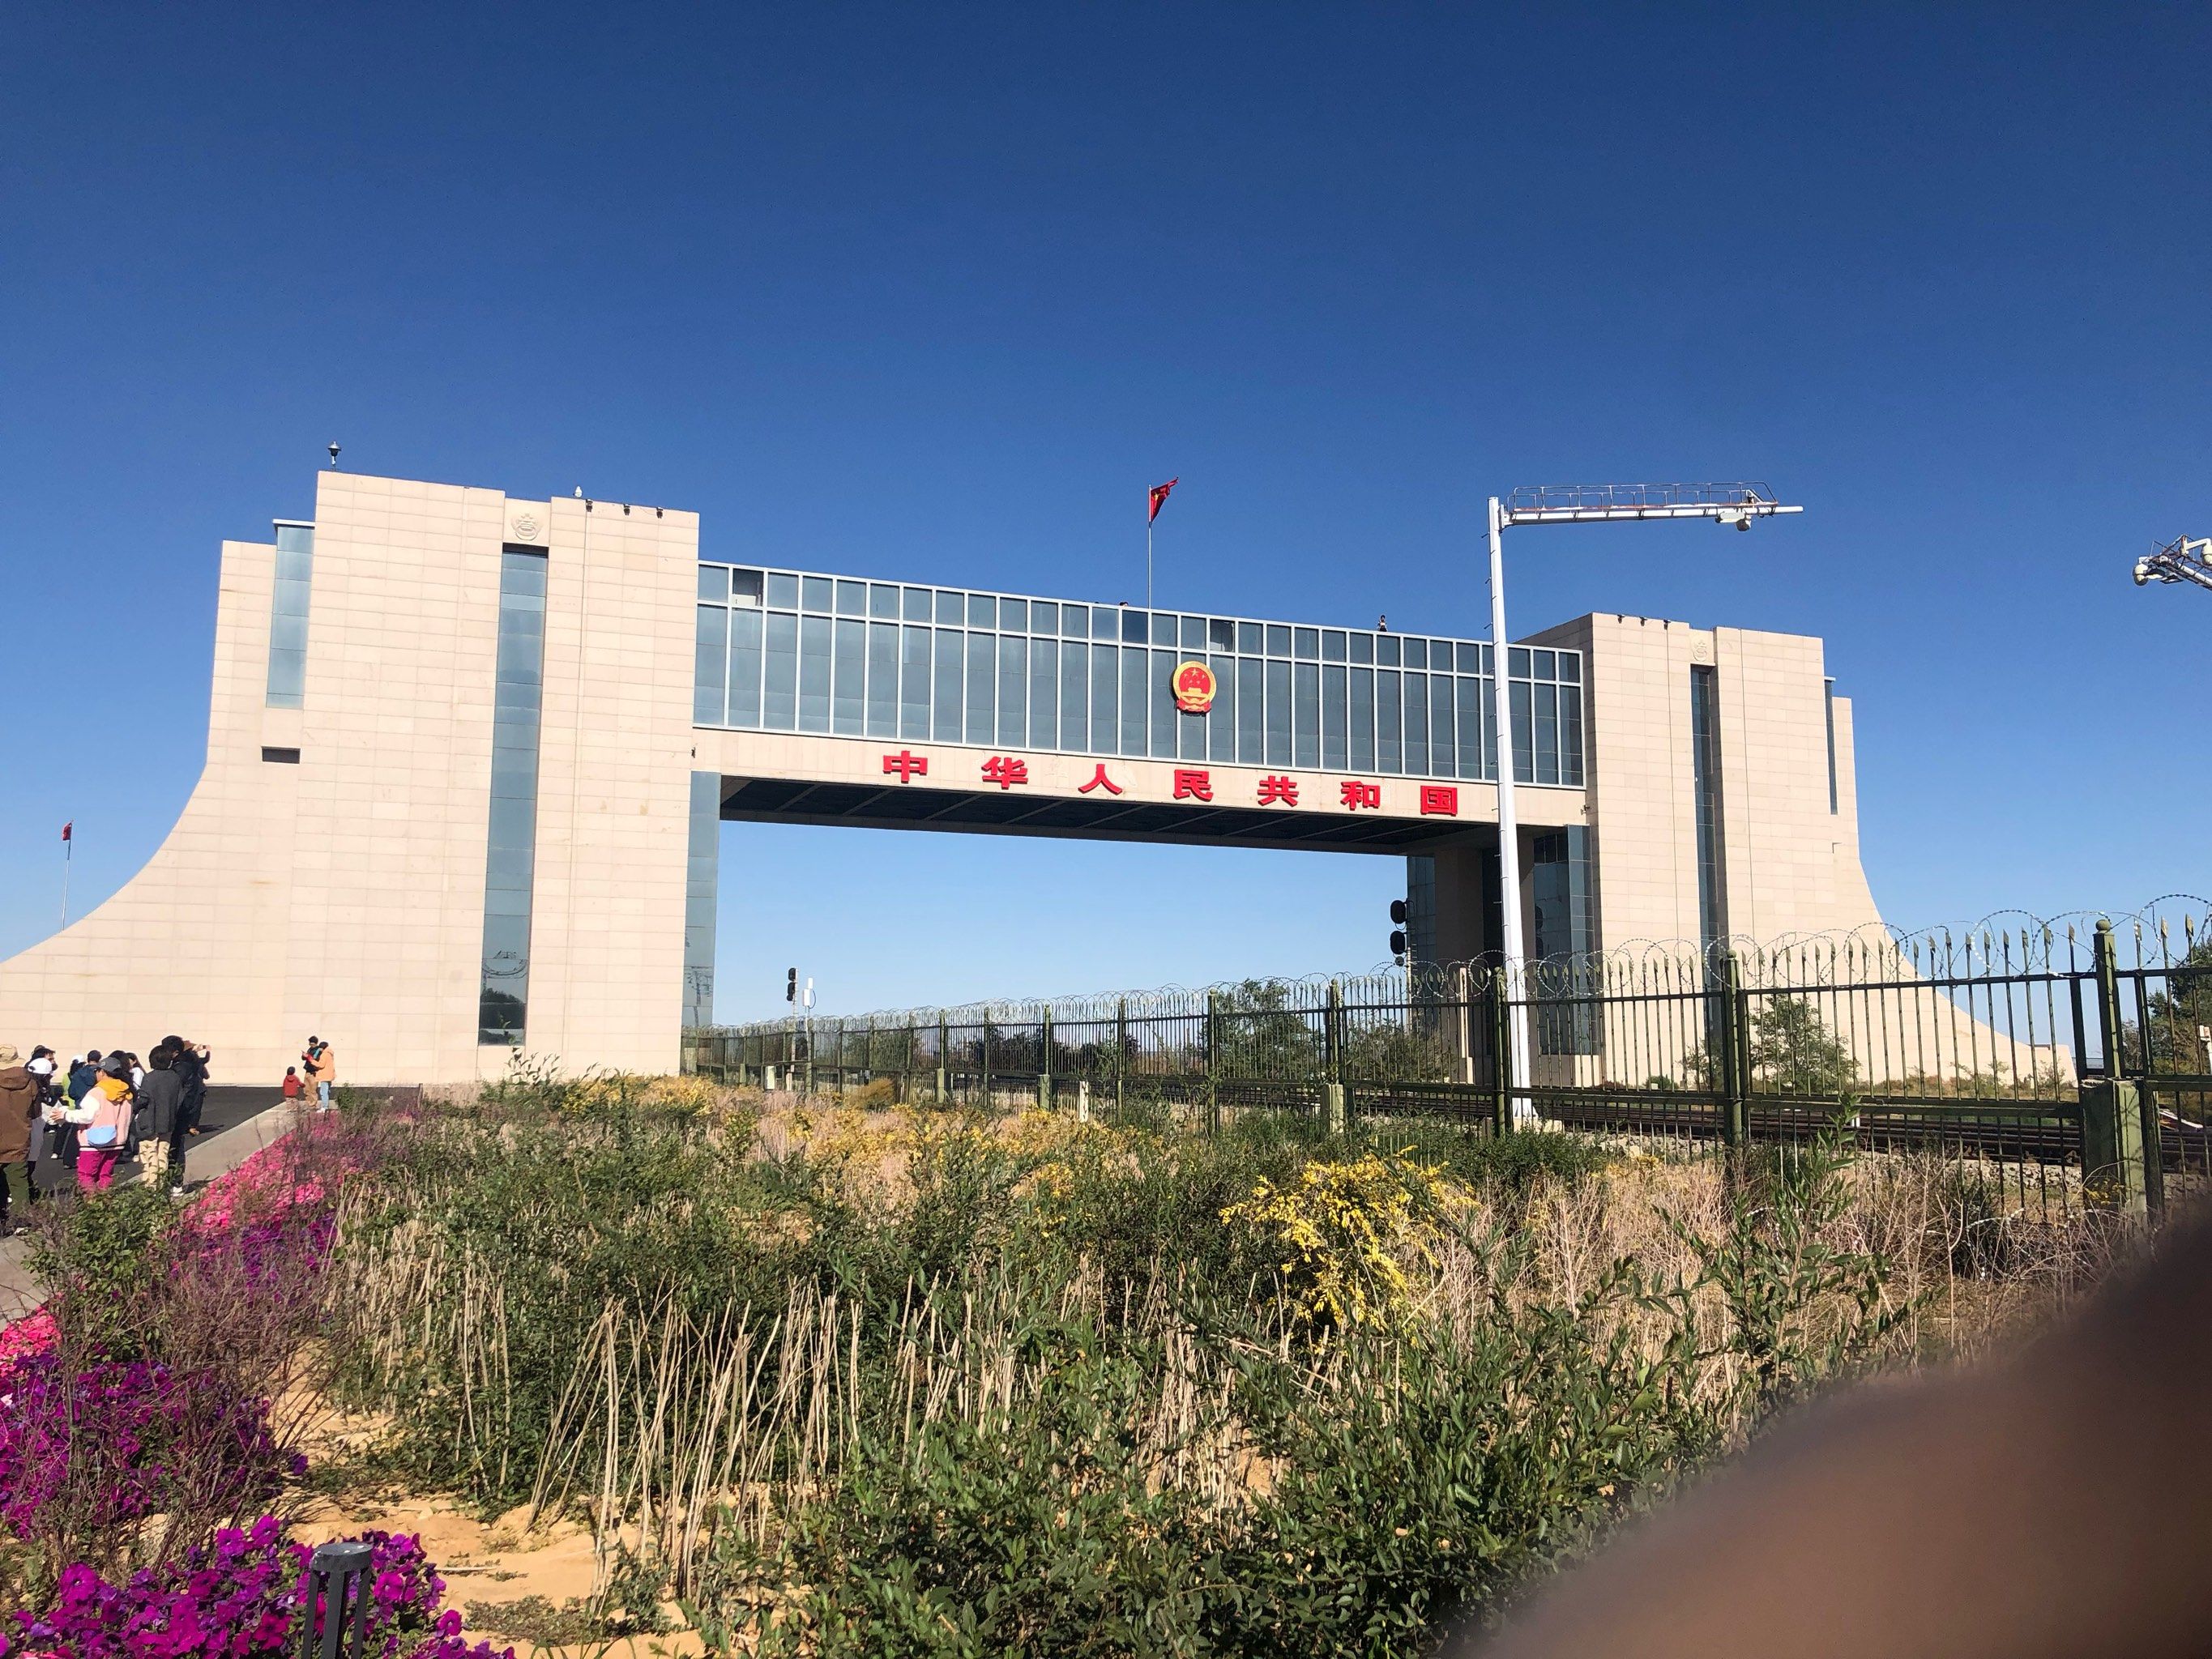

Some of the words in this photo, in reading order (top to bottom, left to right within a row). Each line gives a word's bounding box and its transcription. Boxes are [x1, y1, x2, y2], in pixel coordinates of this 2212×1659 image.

[882, 750, 1458, 817] 中华人民共和国
